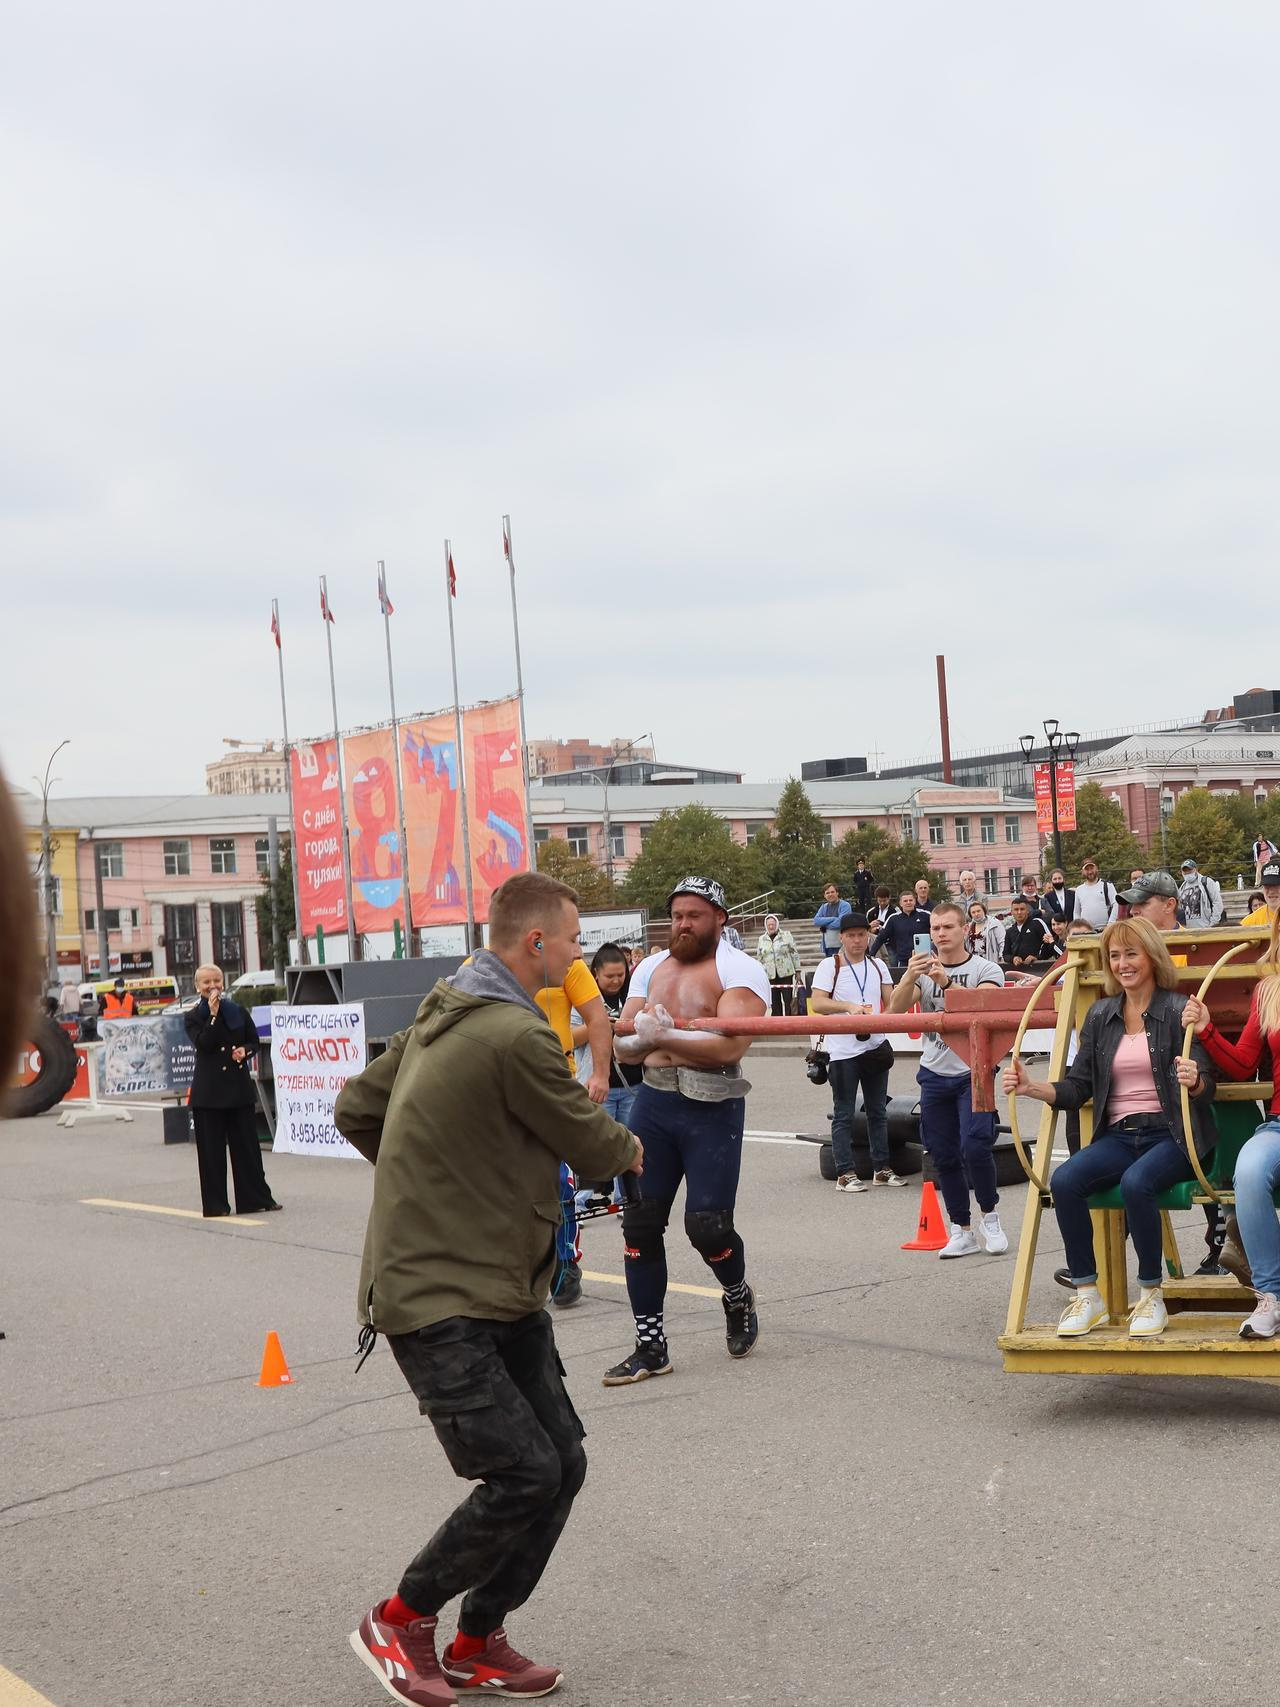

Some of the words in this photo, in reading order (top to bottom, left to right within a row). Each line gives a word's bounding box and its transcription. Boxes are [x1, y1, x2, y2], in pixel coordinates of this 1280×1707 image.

[303, 809, 311, 829] С
[315, 803, 337, 830] днём
[305, 837, 340, 860] города,
[307, 862, 343, 891] туляки!
[279, 1037, 359, 1062] «САЛЮТ»
[290, 1122, 350, 1145] 8-953-962-
[919, 1216, 928, 1231] 4
